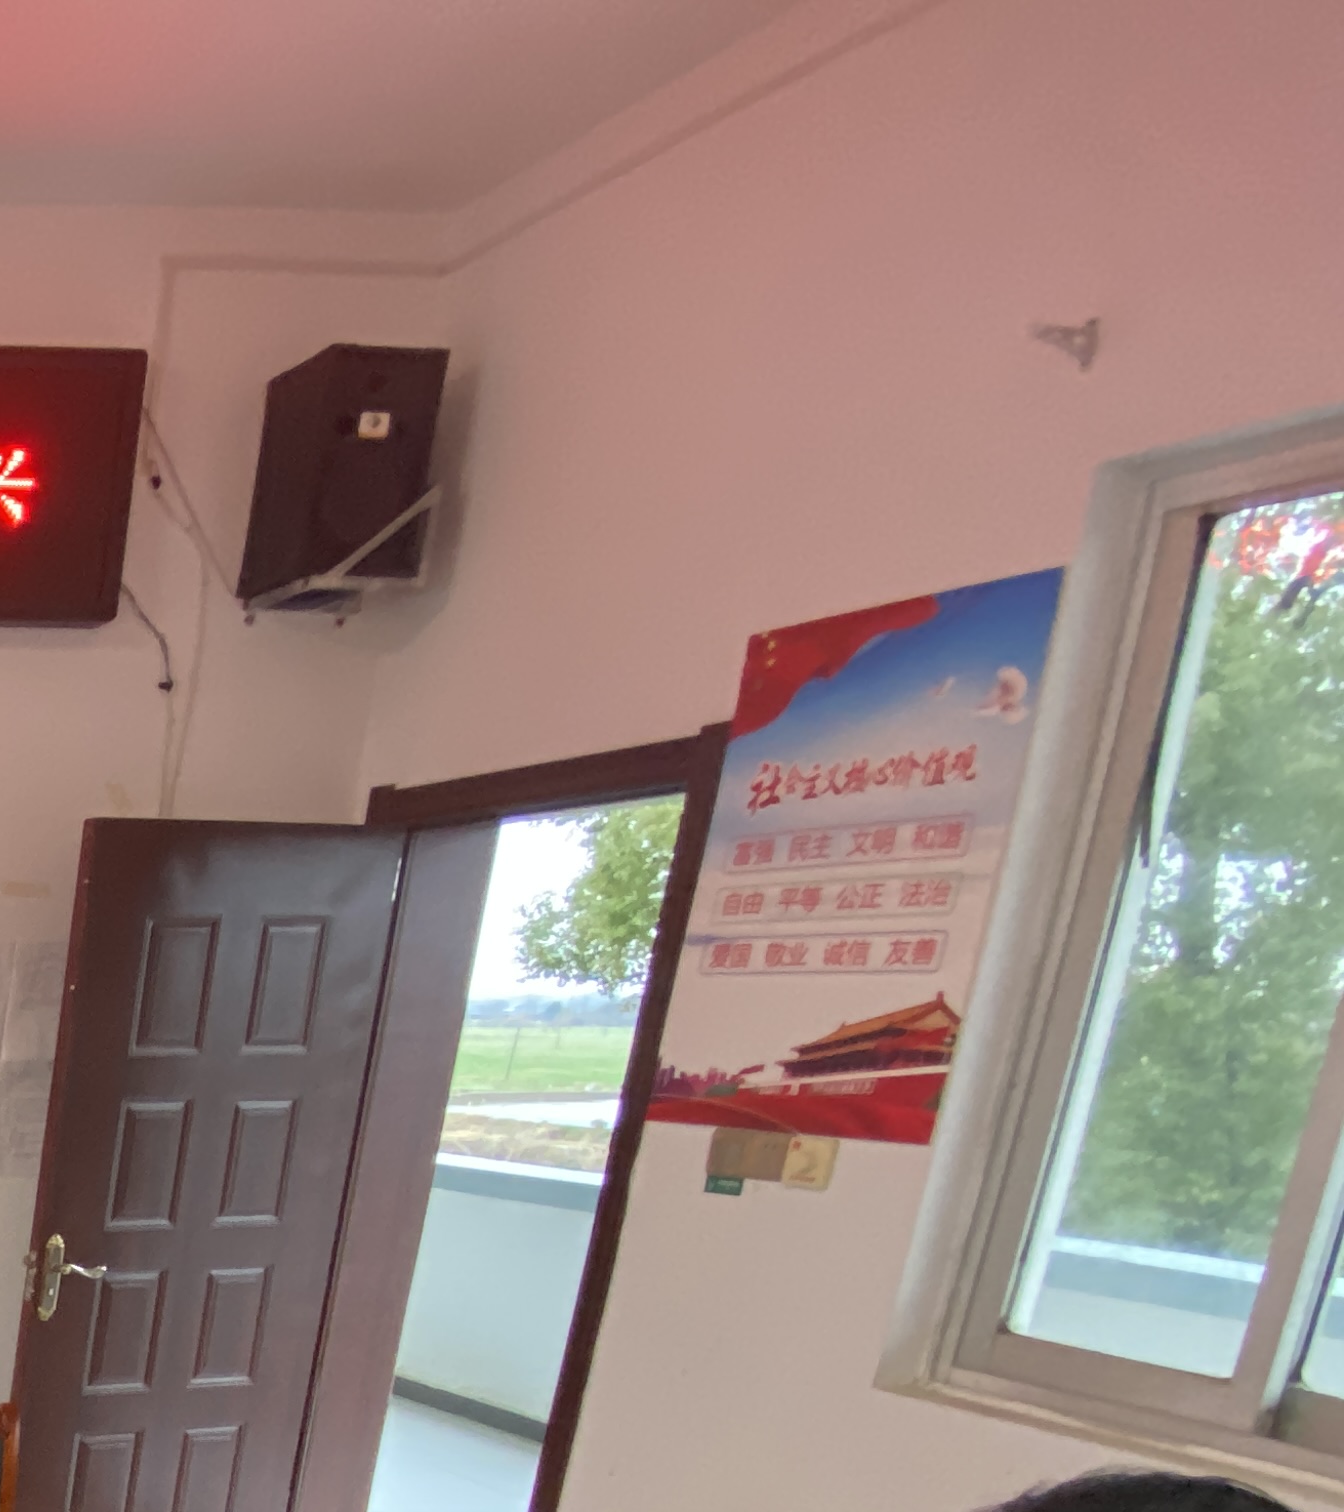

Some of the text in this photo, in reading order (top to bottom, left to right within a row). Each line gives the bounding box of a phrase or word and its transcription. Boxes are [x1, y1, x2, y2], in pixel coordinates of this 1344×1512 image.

[788, 834, 833, 862] 民主
[846, 827, 897, 857] 文明
[914, 821, 964, 850] 和谐
[722, 879, 952, 916] 自由 平等 公正 法治
[709, 938, 938, 968] 爱国 敬业 诚信 友善
